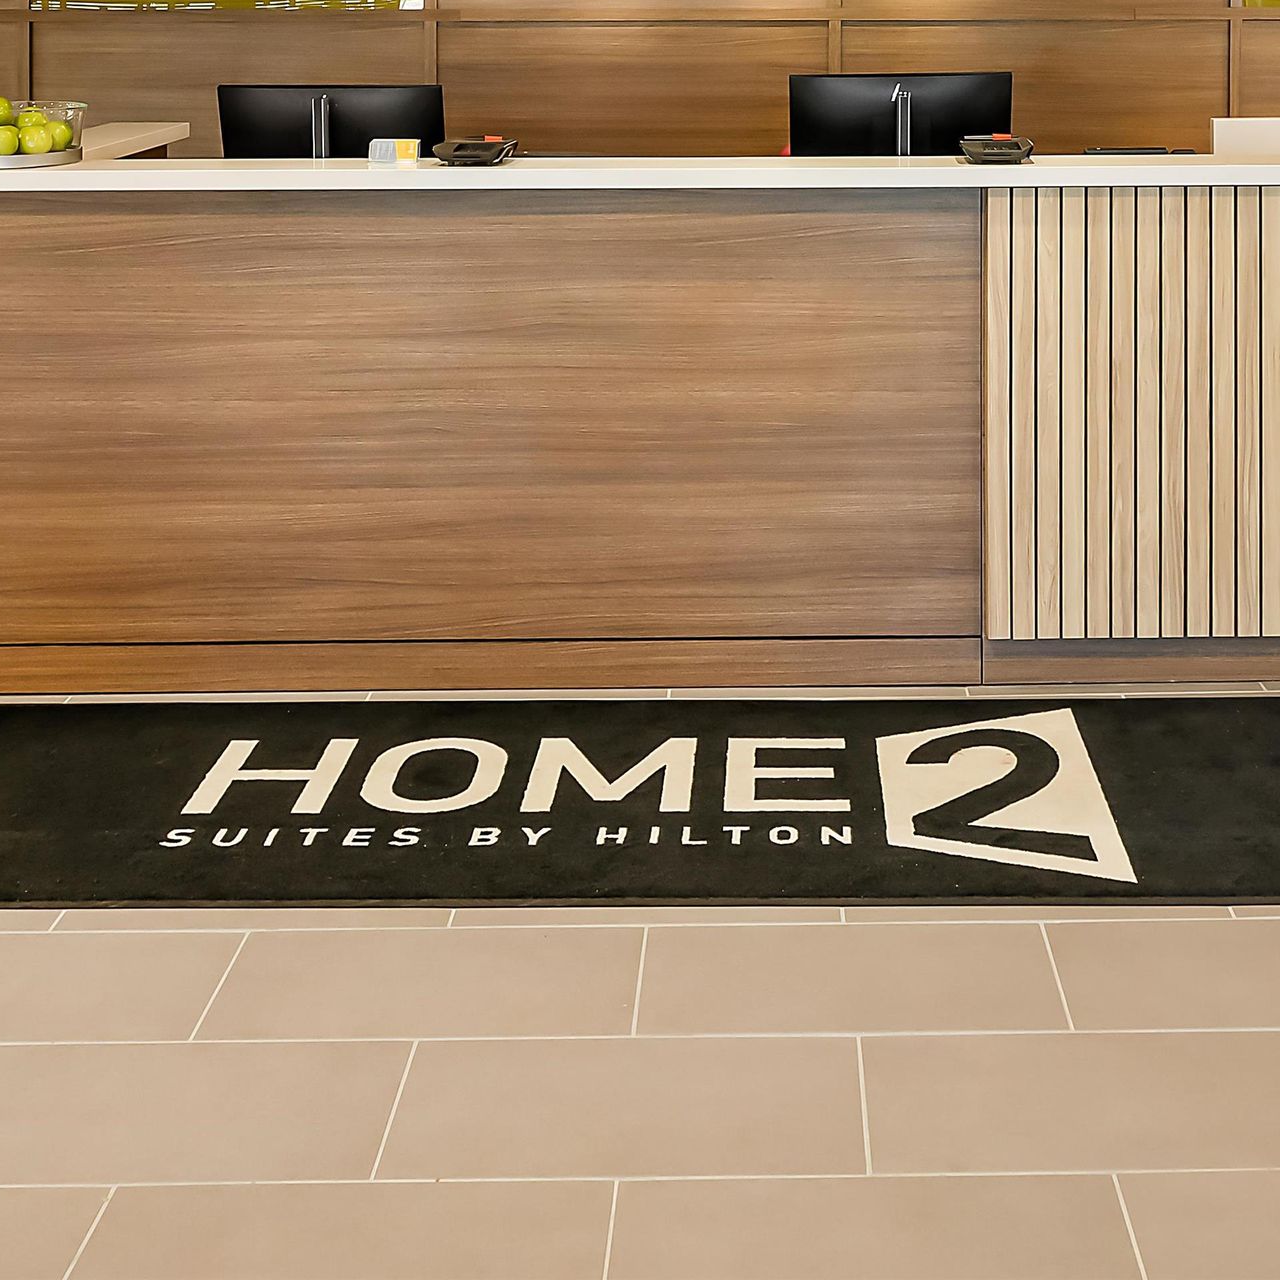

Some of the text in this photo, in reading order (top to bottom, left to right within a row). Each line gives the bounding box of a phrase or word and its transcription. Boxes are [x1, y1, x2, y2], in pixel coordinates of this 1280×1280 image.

[158, 825, 853, 847] SUITES BY HILTON
